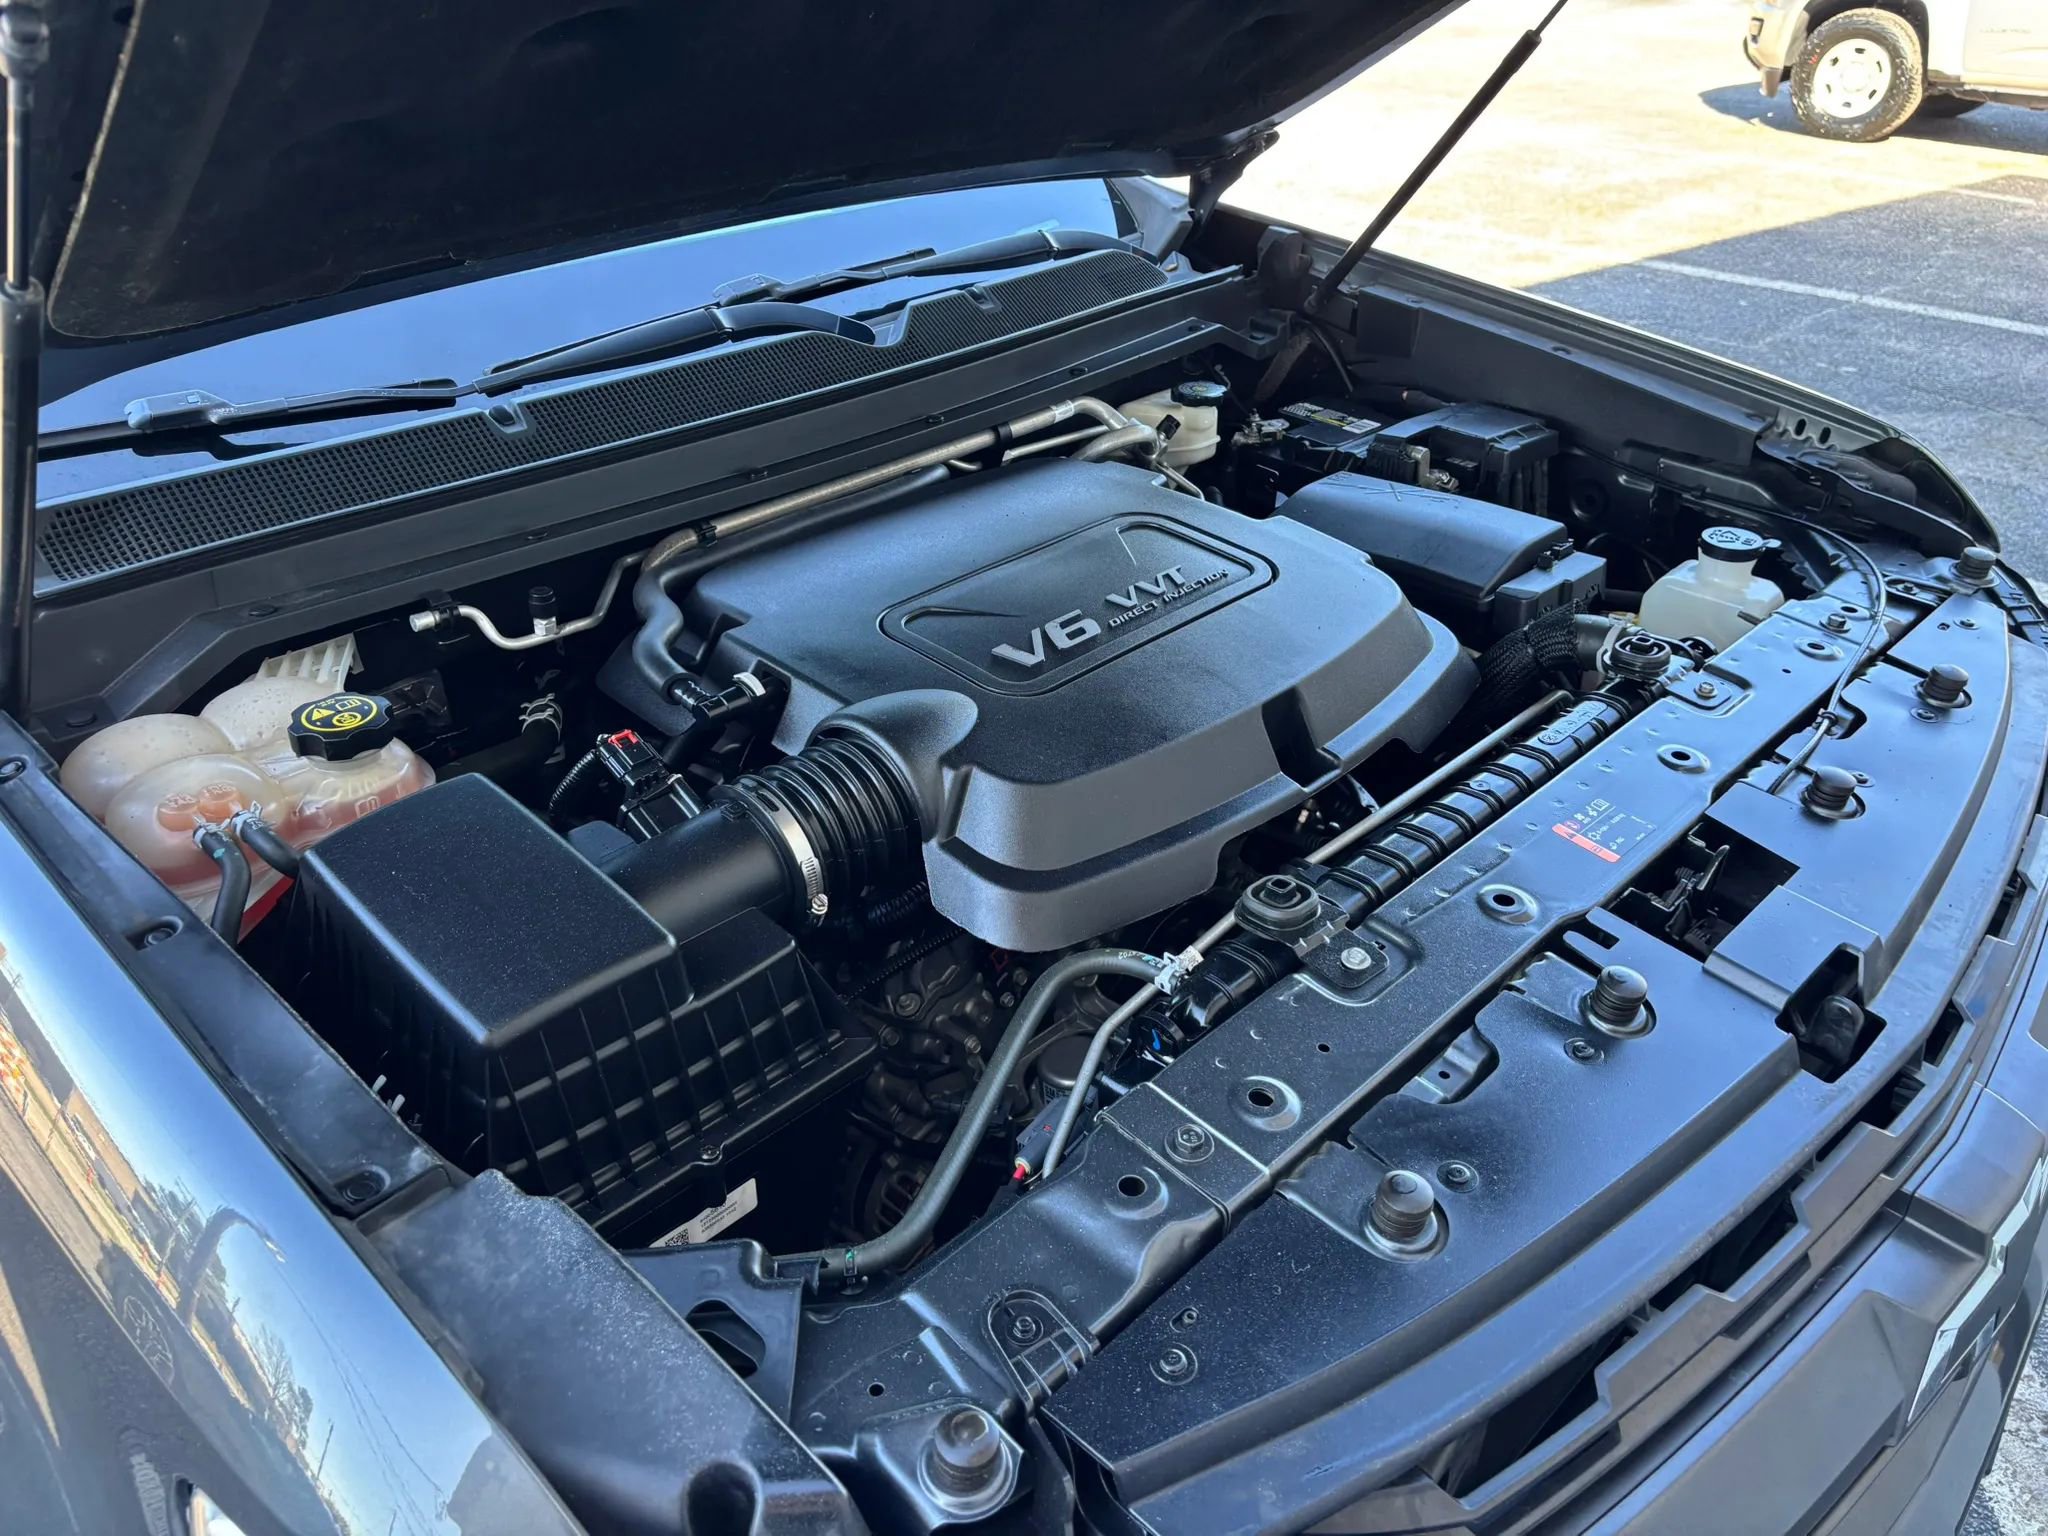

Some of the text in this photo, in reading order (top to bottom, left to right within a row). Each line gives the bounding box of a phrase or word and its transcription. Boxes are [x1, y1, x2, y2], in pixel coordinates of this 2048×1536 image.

[1105, 565, 1187, 608] VVT
[1109, 569, 1228, 627] DIRECT INJECTION
[992, 609, 1101, 667] V6
